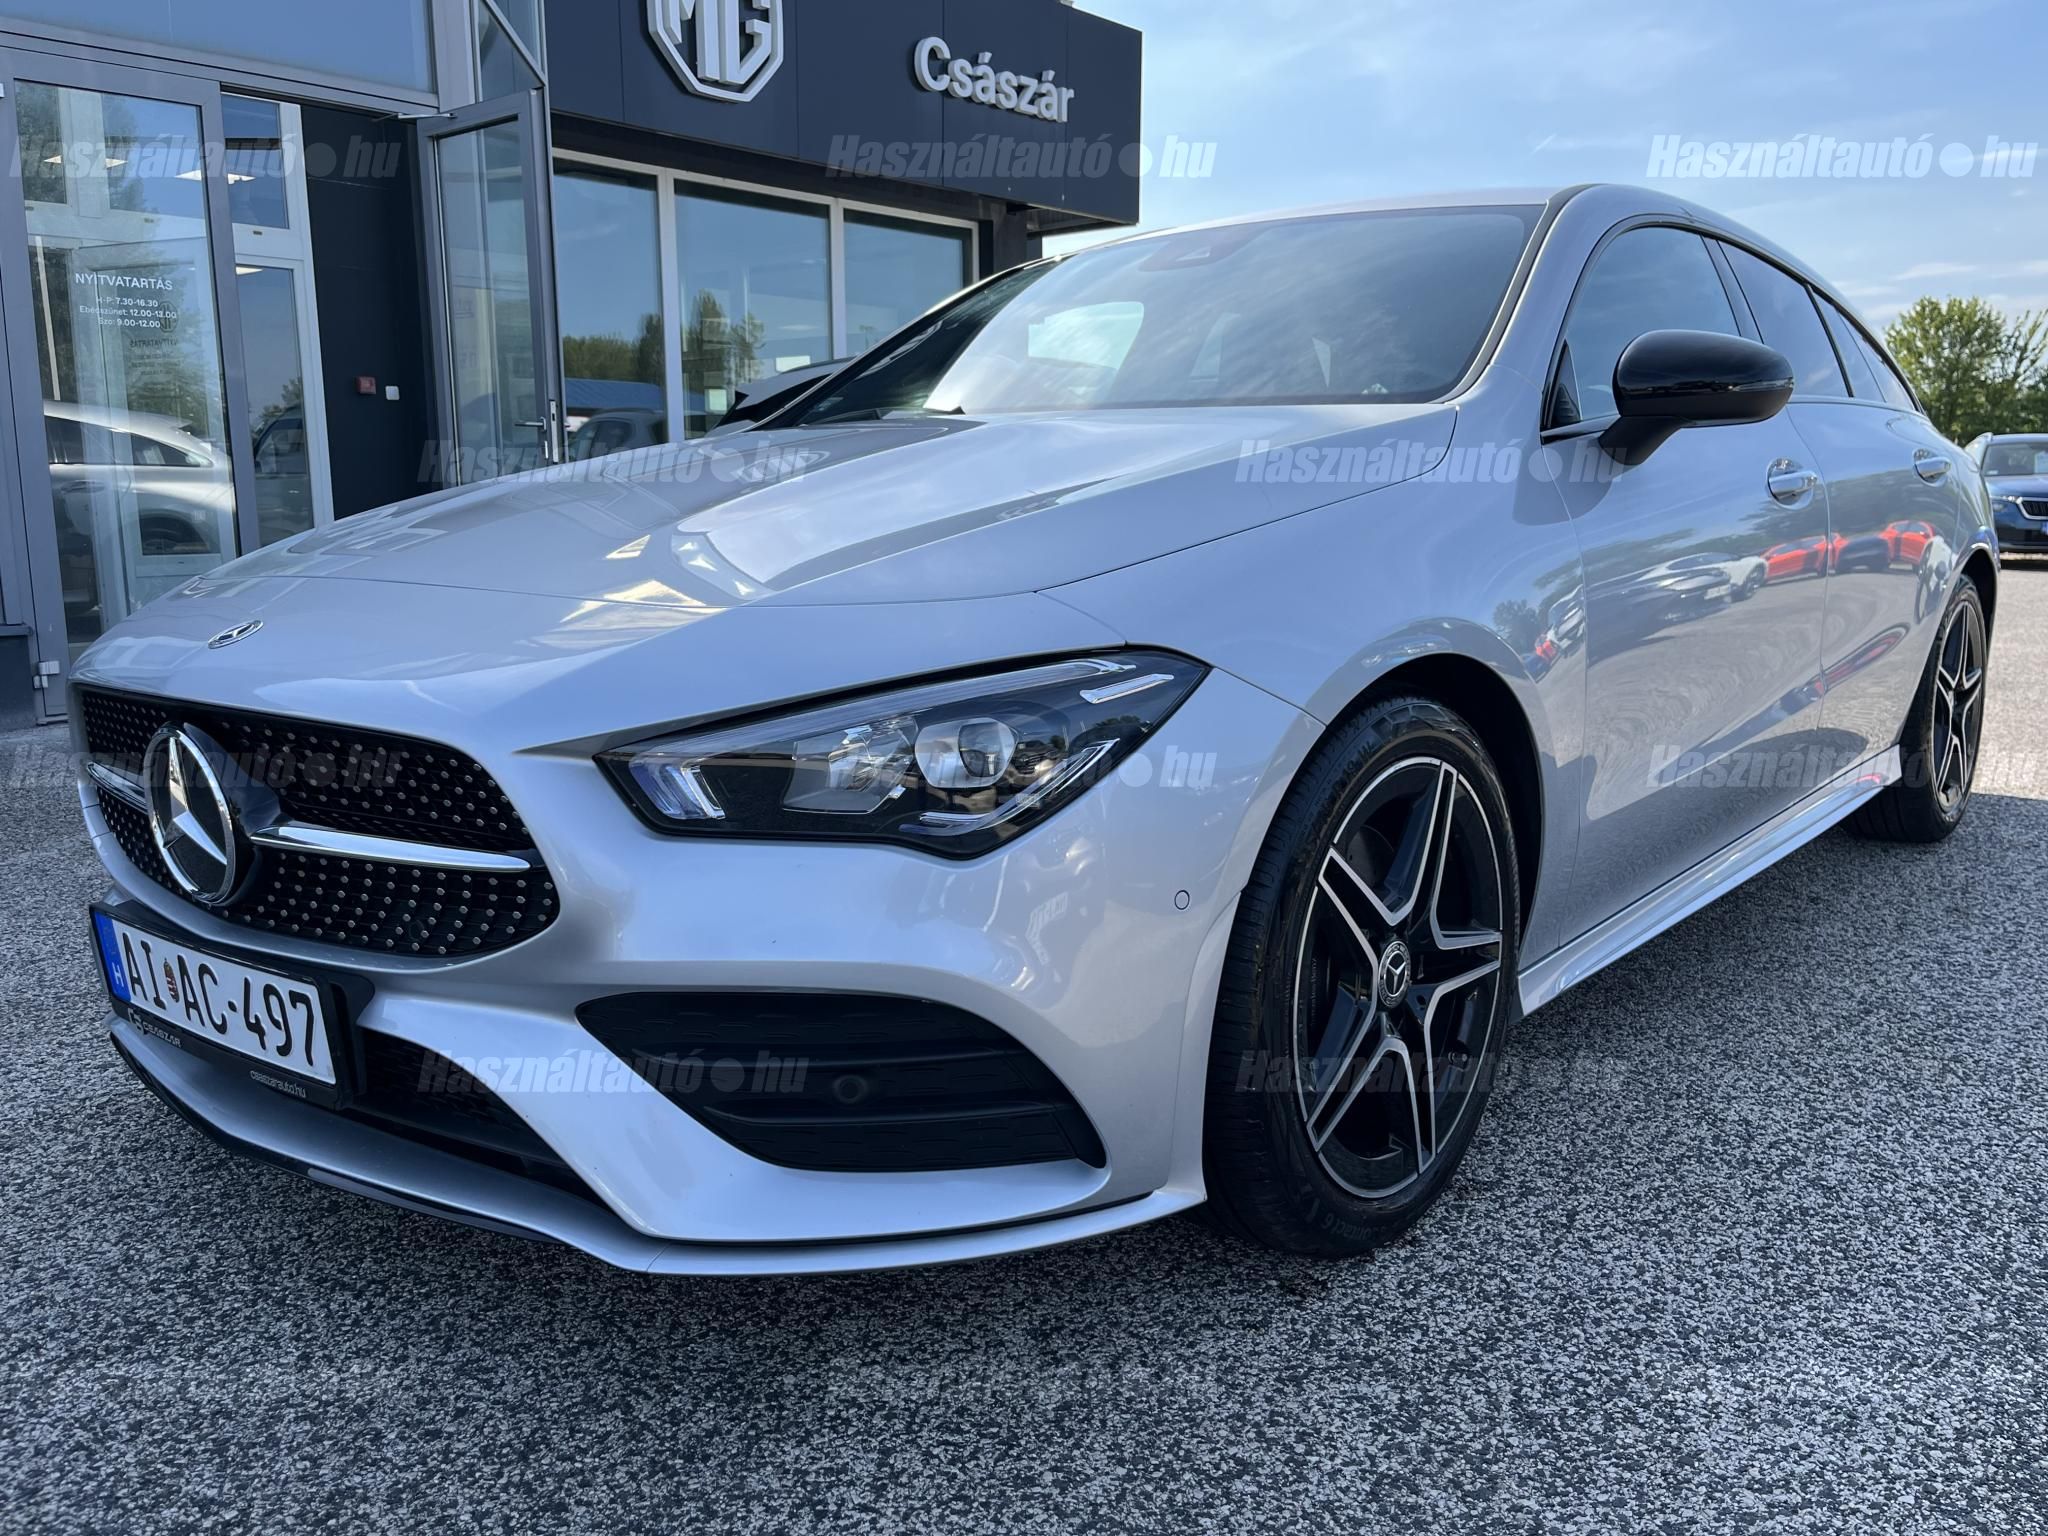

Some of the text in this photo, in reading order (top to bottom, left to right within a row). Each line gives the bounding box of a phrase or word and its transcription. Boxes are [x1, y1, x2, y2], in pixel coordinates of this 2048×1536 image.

[913, 36, 1075, 123] Császár
[75, 273, 173, 291] NYITVATARTÁS
[116, 297, 159, 308] 7.30-16.30
[117, 319, 160, 328] 9.00-12.00
[112, 963, 125, 988] H
